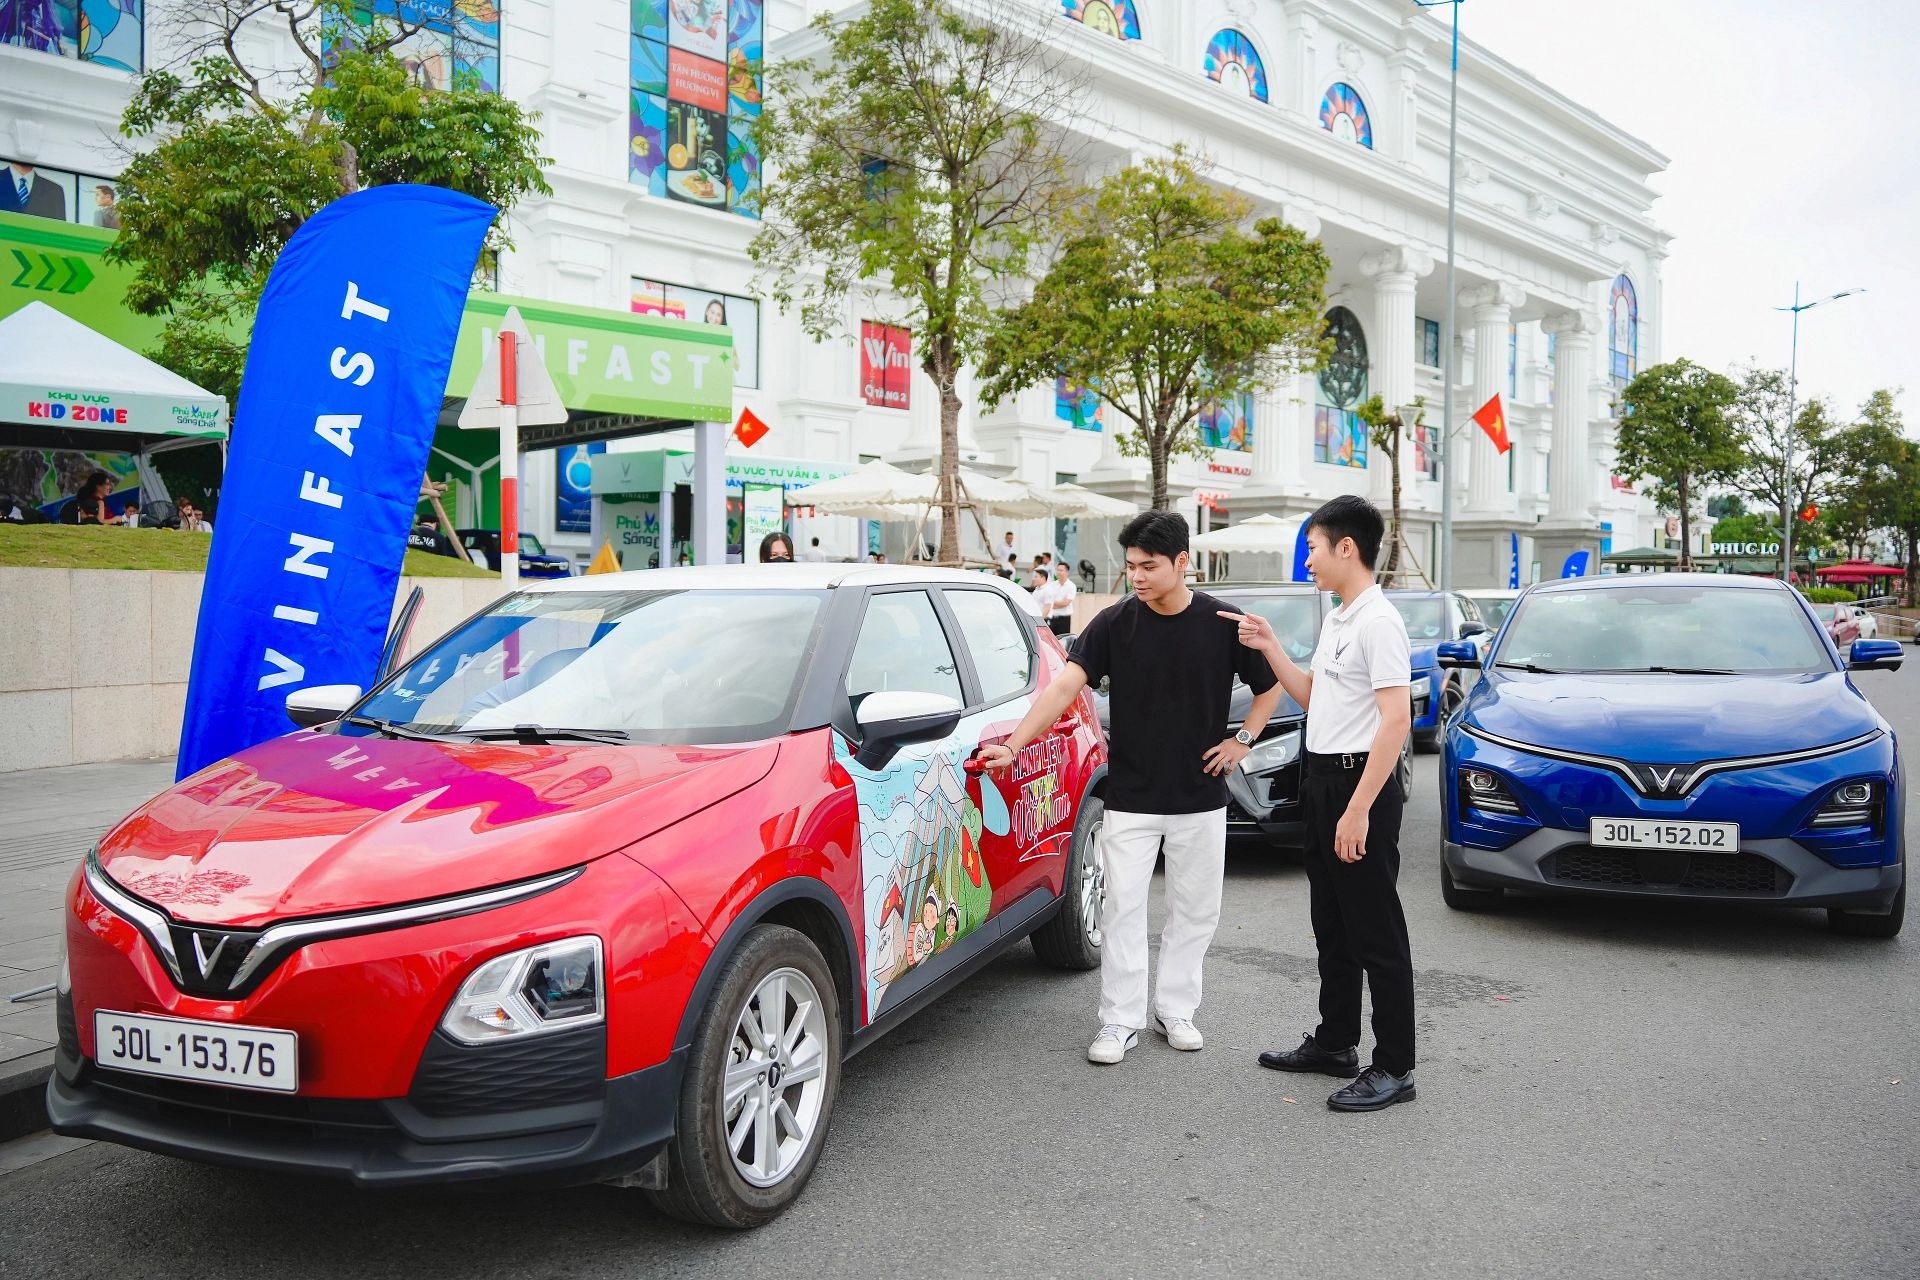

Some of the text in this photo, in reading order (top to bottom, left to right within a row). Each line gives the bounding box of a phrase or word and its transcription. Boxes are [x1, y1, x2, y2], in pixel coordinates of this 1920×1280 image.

[864, 338, 910, 369] Win
[48, 391, 110, 406] KHU VỰC
[900, 393, 907, 402] 2
[28, 402, 128, 424] KID ZONE
[812, 470, 820, 479] &
[258, 281, 390, 691] VINFAST
[1709, 543, 1757, 555] PHUC
[1604, 823, 1725, 847] 30L-152.02
[111, 1024, 275, 1077] 30L-153.76
